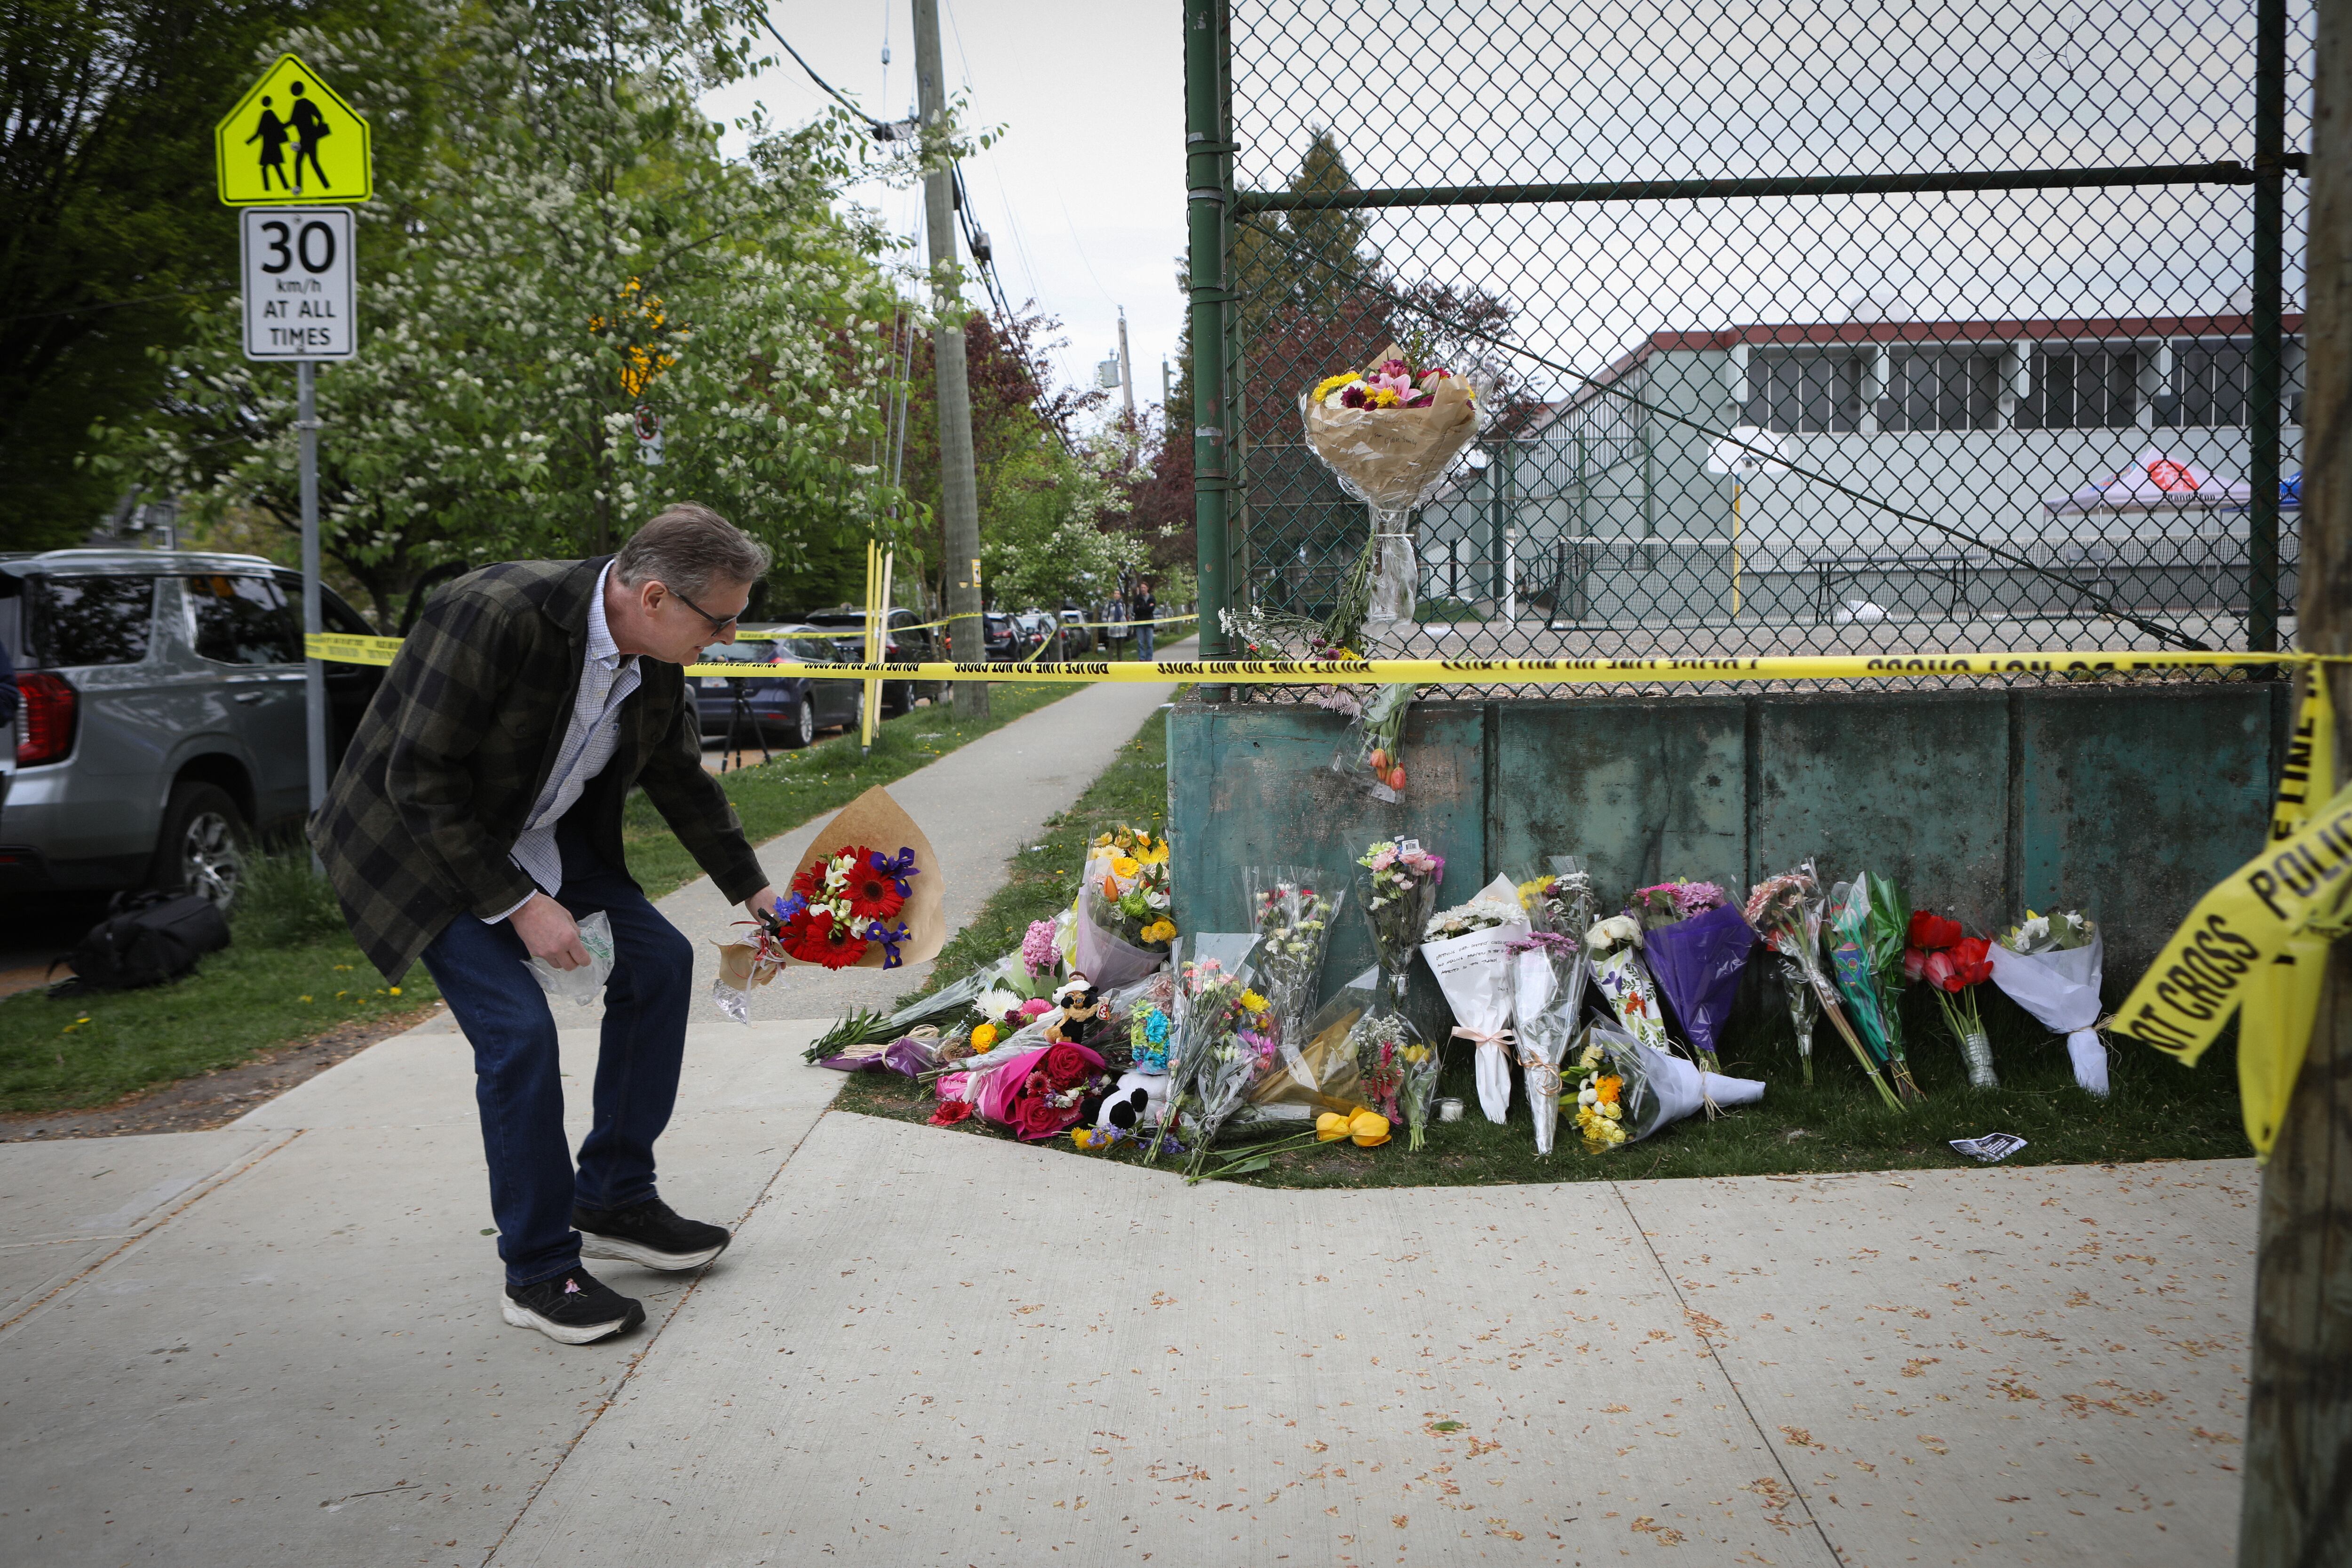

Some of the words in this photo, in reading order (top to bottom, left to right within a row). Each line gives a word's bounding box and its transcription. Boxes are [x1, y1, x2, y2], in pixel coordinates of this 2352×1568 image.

[261, 221, 335, 273] 30
[263, 300, 289, 318] AT
[298, 300, 336, 318] ALL
[276, 278, 321, 294] km/h
[269, 327, 331, 345] TIMES
[2247, 810, 2352, 921] POLIC
[2156, 914, 2260, 1021] CROSS
[2129, 1002, 2198, 1051] OT
